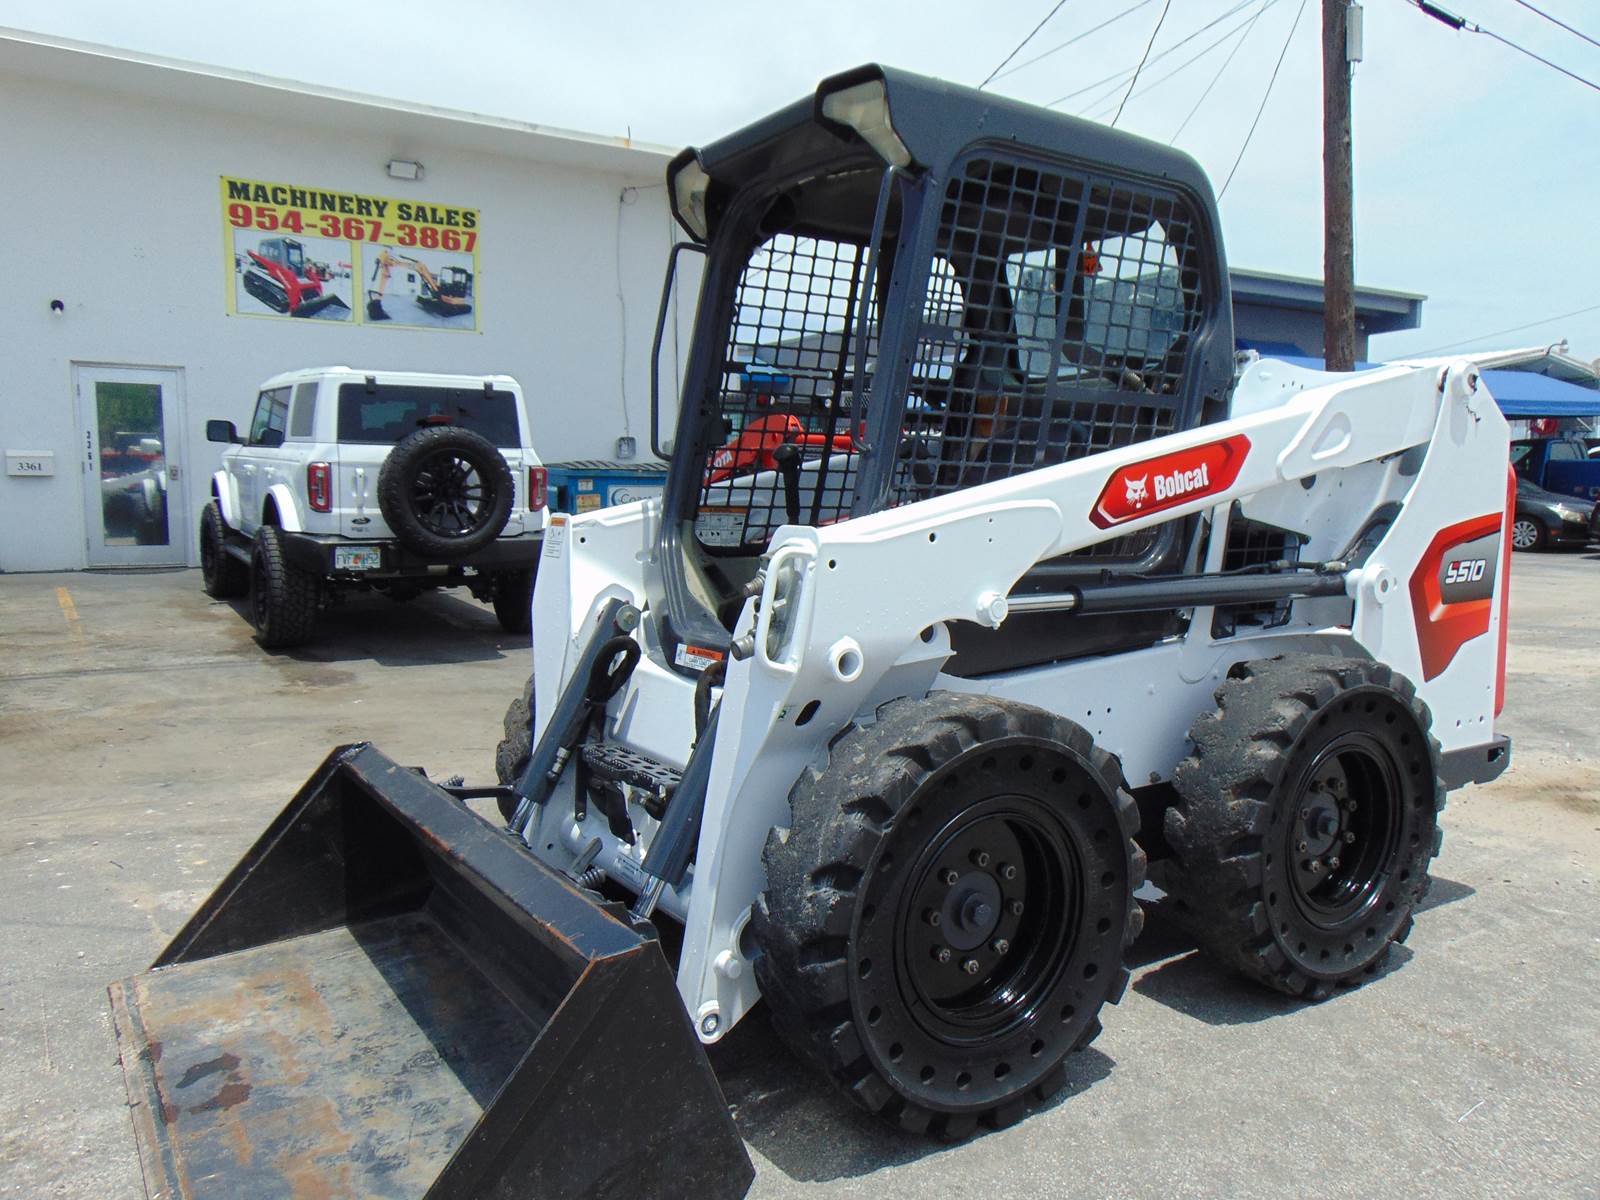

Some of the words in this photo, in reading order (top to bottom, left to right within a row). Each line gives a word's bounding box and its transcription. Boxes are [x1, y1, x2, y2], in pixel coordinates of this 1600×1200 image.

[227, 180, 388, 218] MACHINERY
[397, 203, 476, 228] SALES
[229, 203, 477, 252] 954-367-3867
[17, 462, 42, 471] 3361
[1153, 462, 1209, 501] Bobcat
[1445, 559, 1486, 584] S510
